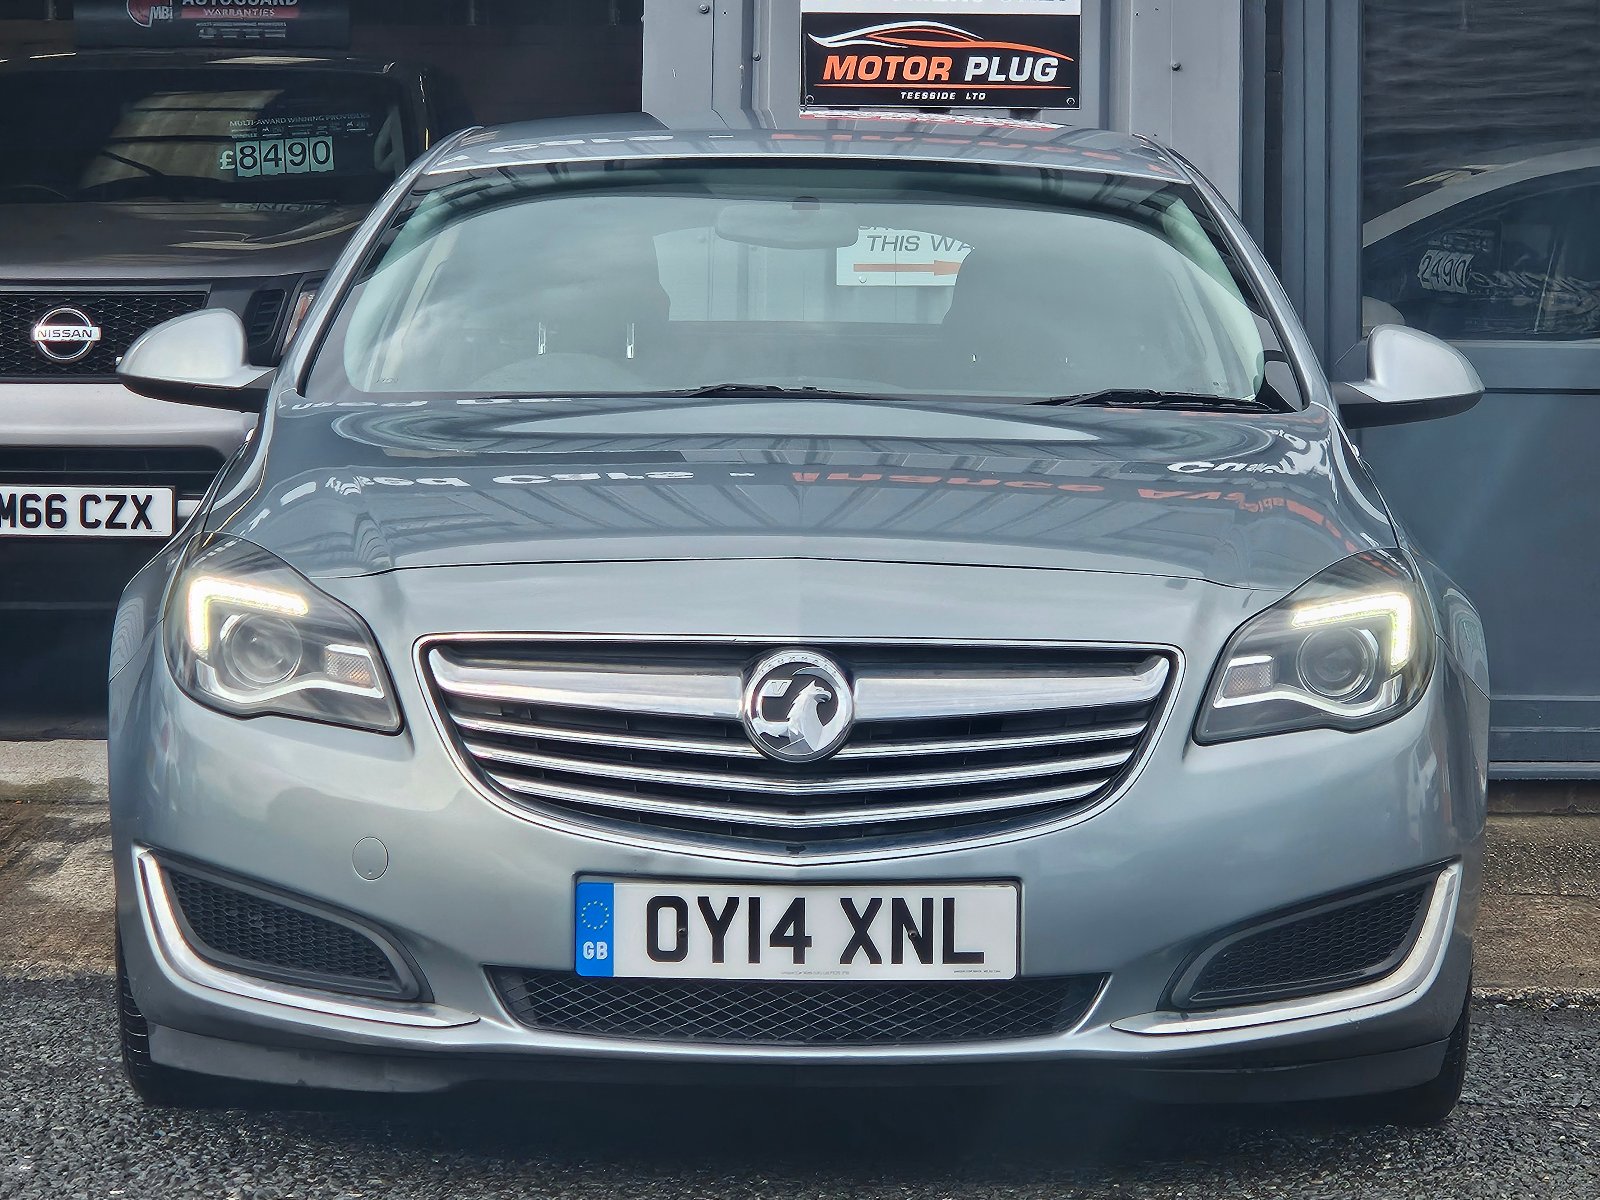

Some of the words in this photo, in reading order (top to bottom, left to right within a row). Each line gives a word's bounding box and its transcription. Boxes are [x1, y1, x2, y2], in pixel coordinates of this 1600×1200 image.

[203, 8, 275, 17] WARRANTIES
[822, 55, 954, 81] MOTOR
[964, 56, 1059, 82] PLUG
[900, 92, 956, 100] TEESSIDE
[965, 92, 986, 100] LTD
[219, 140, 331, 170] £8490
[867, 235, 921, 252] THIS
[1420, 255, 1468, 288] 2490
[37, 329, 93, 338] NISSAN
[79, 494, 153, 530] CZX
[646, 895, 812, 964] OY14
[839, 897, 985, 965] XNL
[582, 941, 608, 960] GB
